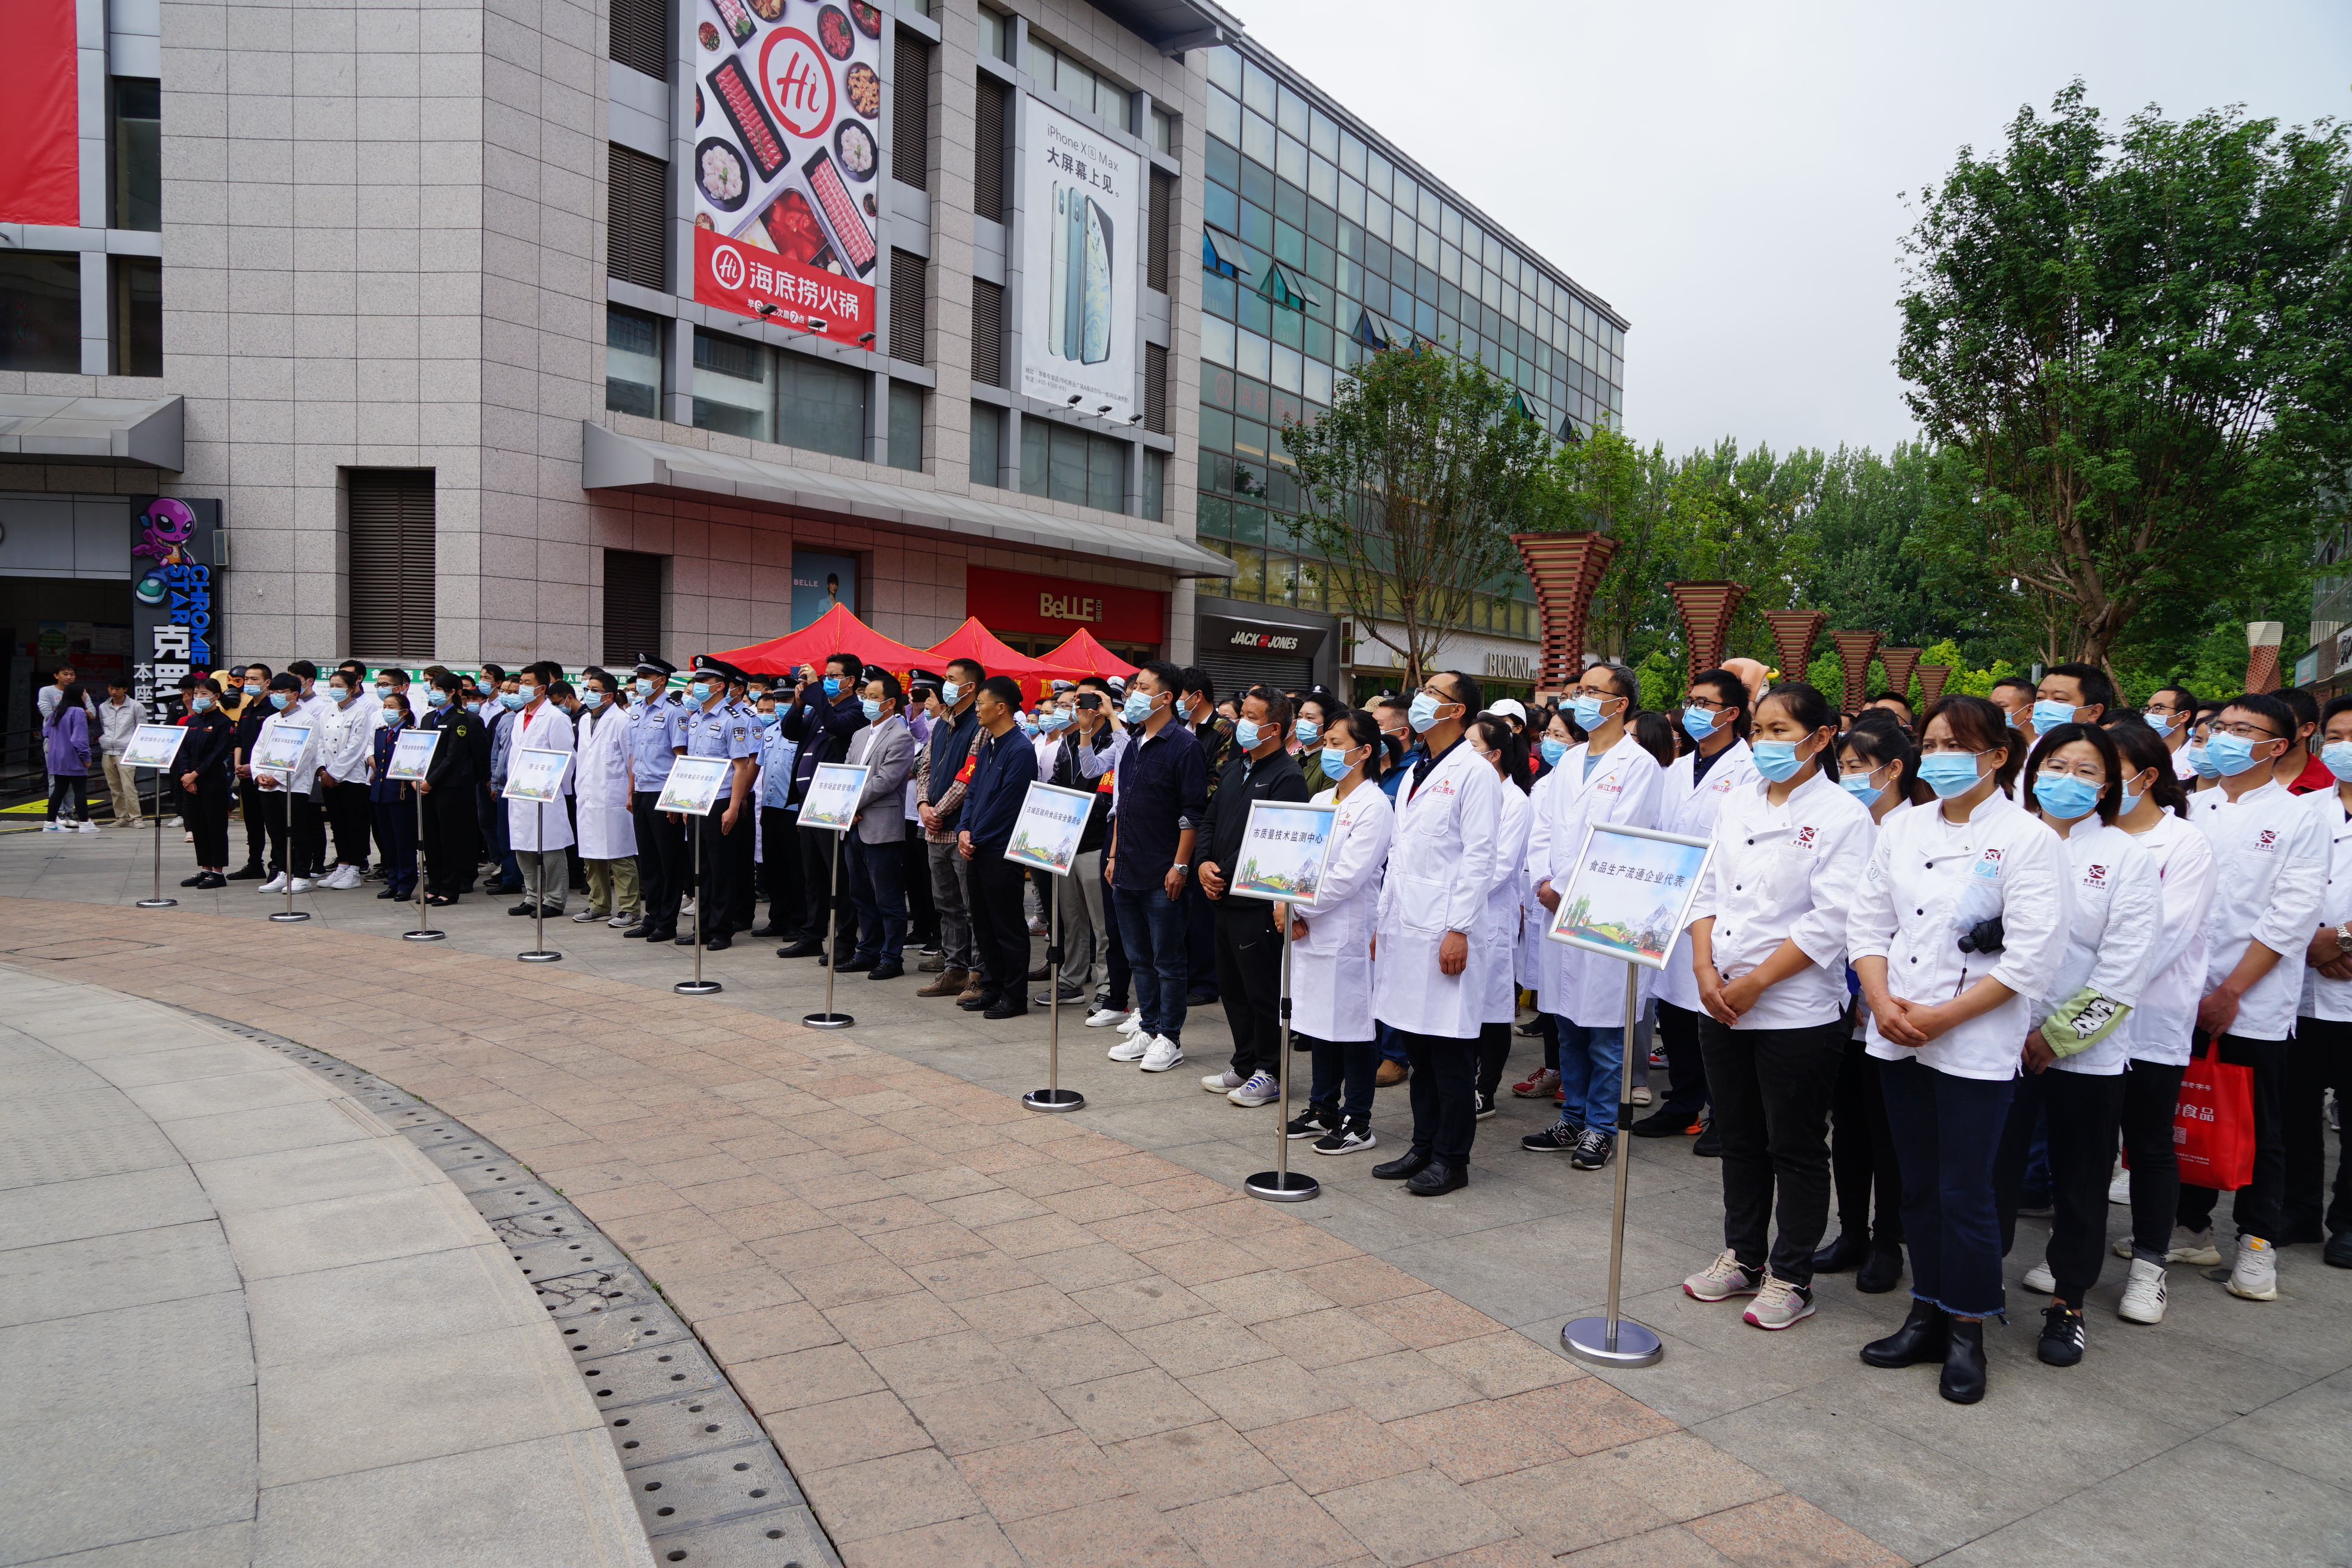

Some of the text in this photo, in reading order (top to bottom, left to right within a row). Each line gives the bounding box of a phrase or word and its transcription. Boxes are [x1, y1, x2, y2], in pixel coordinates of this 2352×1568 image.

[776, 51, 820, 114] Hi
[1048, 124, 1079, 151] iPhone
[1099, 152, 1118, 172] Max
[1047, 146, 1119, 197] 大屏幕上见。
[719, 254, 738, 278] Hi
[749, 261, 859, 321] 海底捞火锅
[170, 564, 191, 624] STAR
[794, 578, 818, 587] BELLE
[190, 565, 211, 665] CHROME
[1230, 631, 1298, 650] JACK JONES
[1488, 653, 1531, 680] BURINI
[528, 763, 552, 772] 市公安局
[819, 782, 856, 792] 市市场监督管理局
[1027, 806, 1082, 825] 古城区政府食品安全委员会
[1253, 828, 1323, 844] 市质量技术监测中心
[1589, 860, 1686, 888] 食品生产流通企业代表
